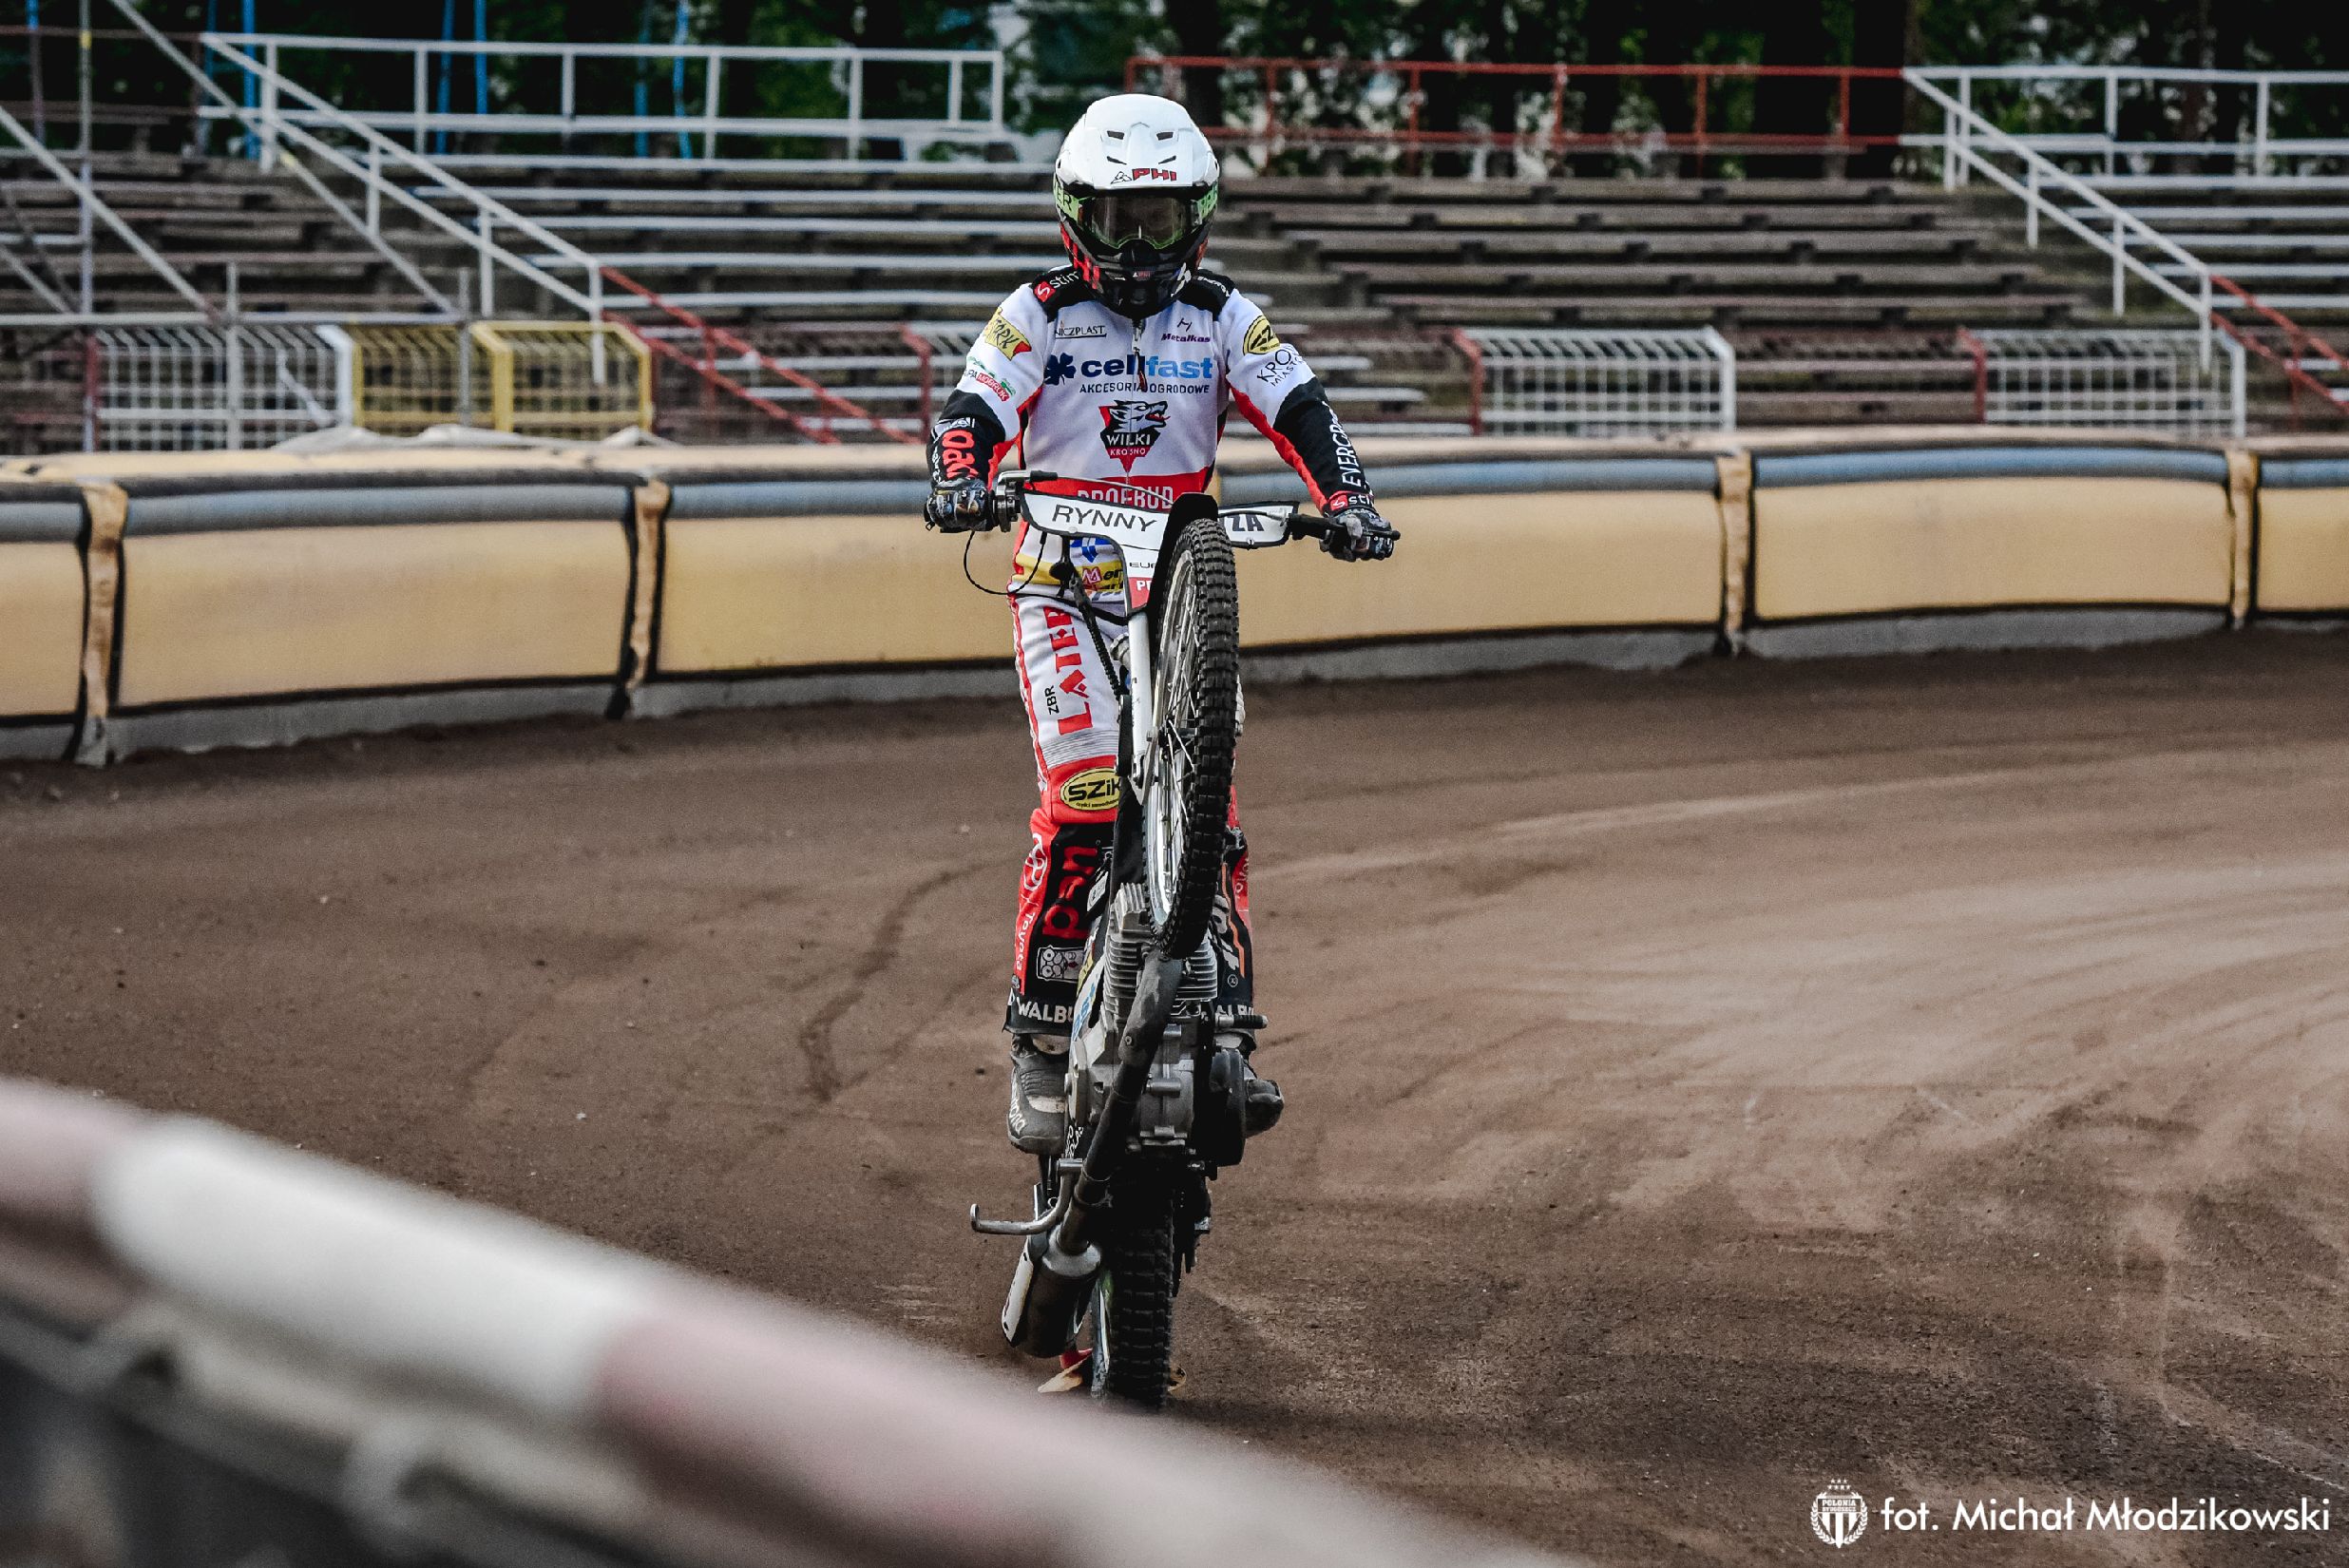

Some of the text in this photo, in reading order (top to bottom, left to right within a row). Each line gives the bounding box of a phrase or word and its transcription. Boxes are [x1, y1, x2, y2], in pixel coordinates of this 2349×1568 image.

[1132, 167, 1177, 182] PHI
[1161, 333, 1211, 343] Metalkas
[1080, 354, 1213, 379] cellfast
[1079, 381, 1210, 394] AKCESORIA OGRODOWE
[1106, 433, 1152, 447] WILKI
[1110, 448, 1146, 457] KROSNO
[1051, 503, 1157, 532] RYNNY
[1044, 684, 1060, 716] ZBR
[1016, 912, 1036, 971] Toyota
